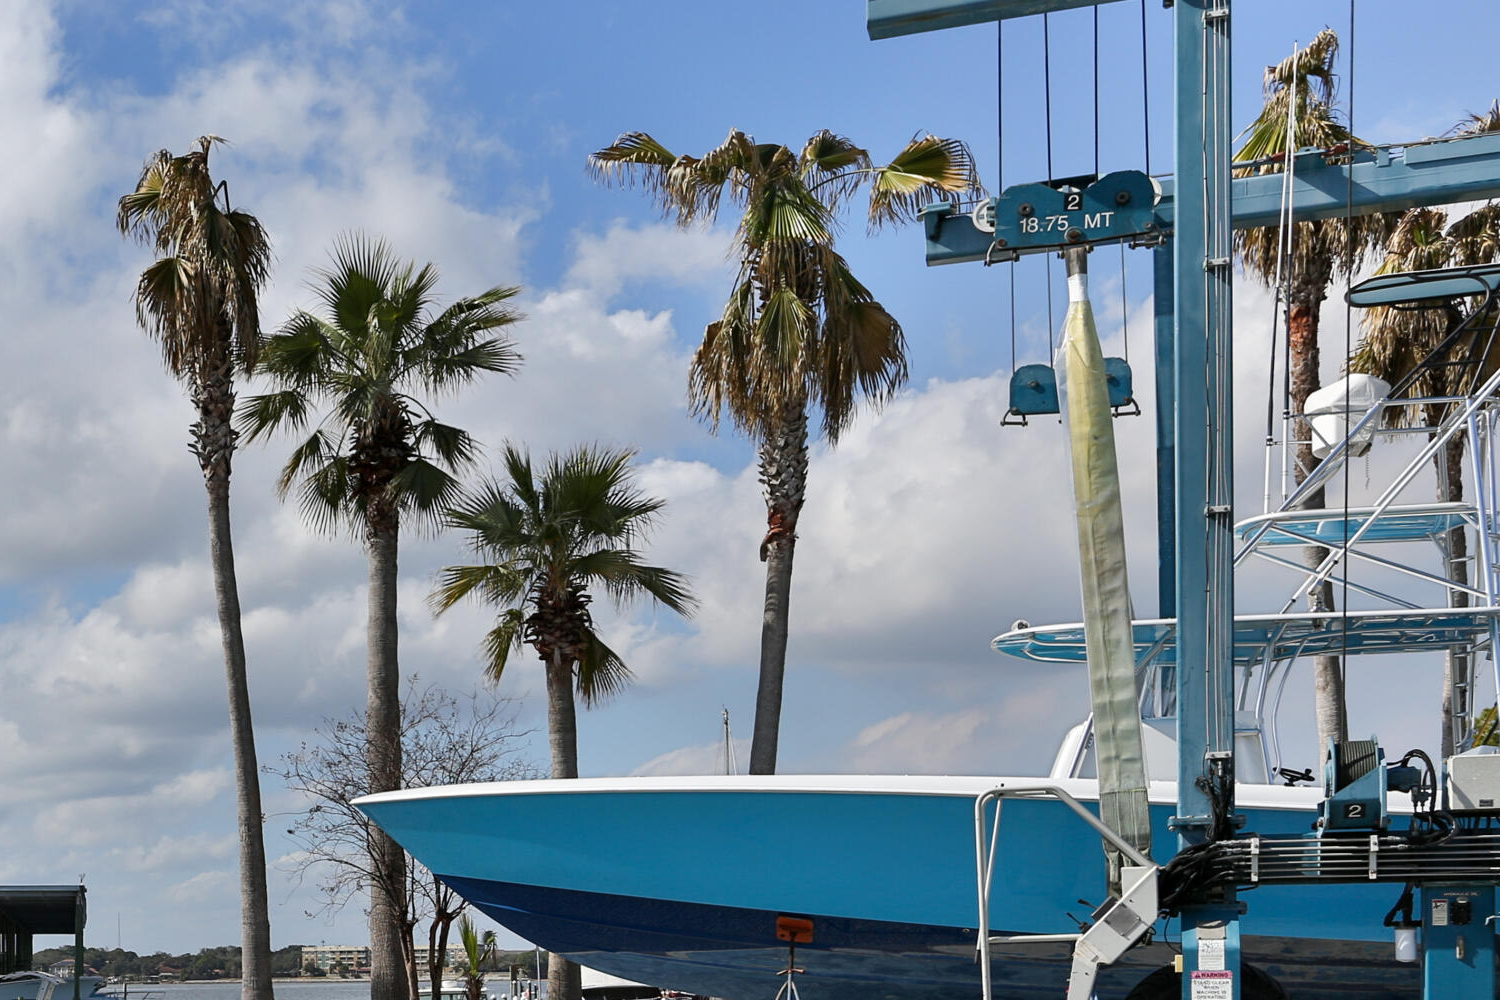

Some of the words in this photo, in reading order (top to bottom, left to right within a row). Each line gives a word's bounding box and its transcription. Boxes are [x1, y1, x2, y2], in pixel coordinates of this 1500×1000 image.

[1067, 194, 1080, 210] 2
[1019, 214, 1069, 234] 18.75
[1084, 211, 1115, 230] MT
[1347, 804, 1362, 818] 2
